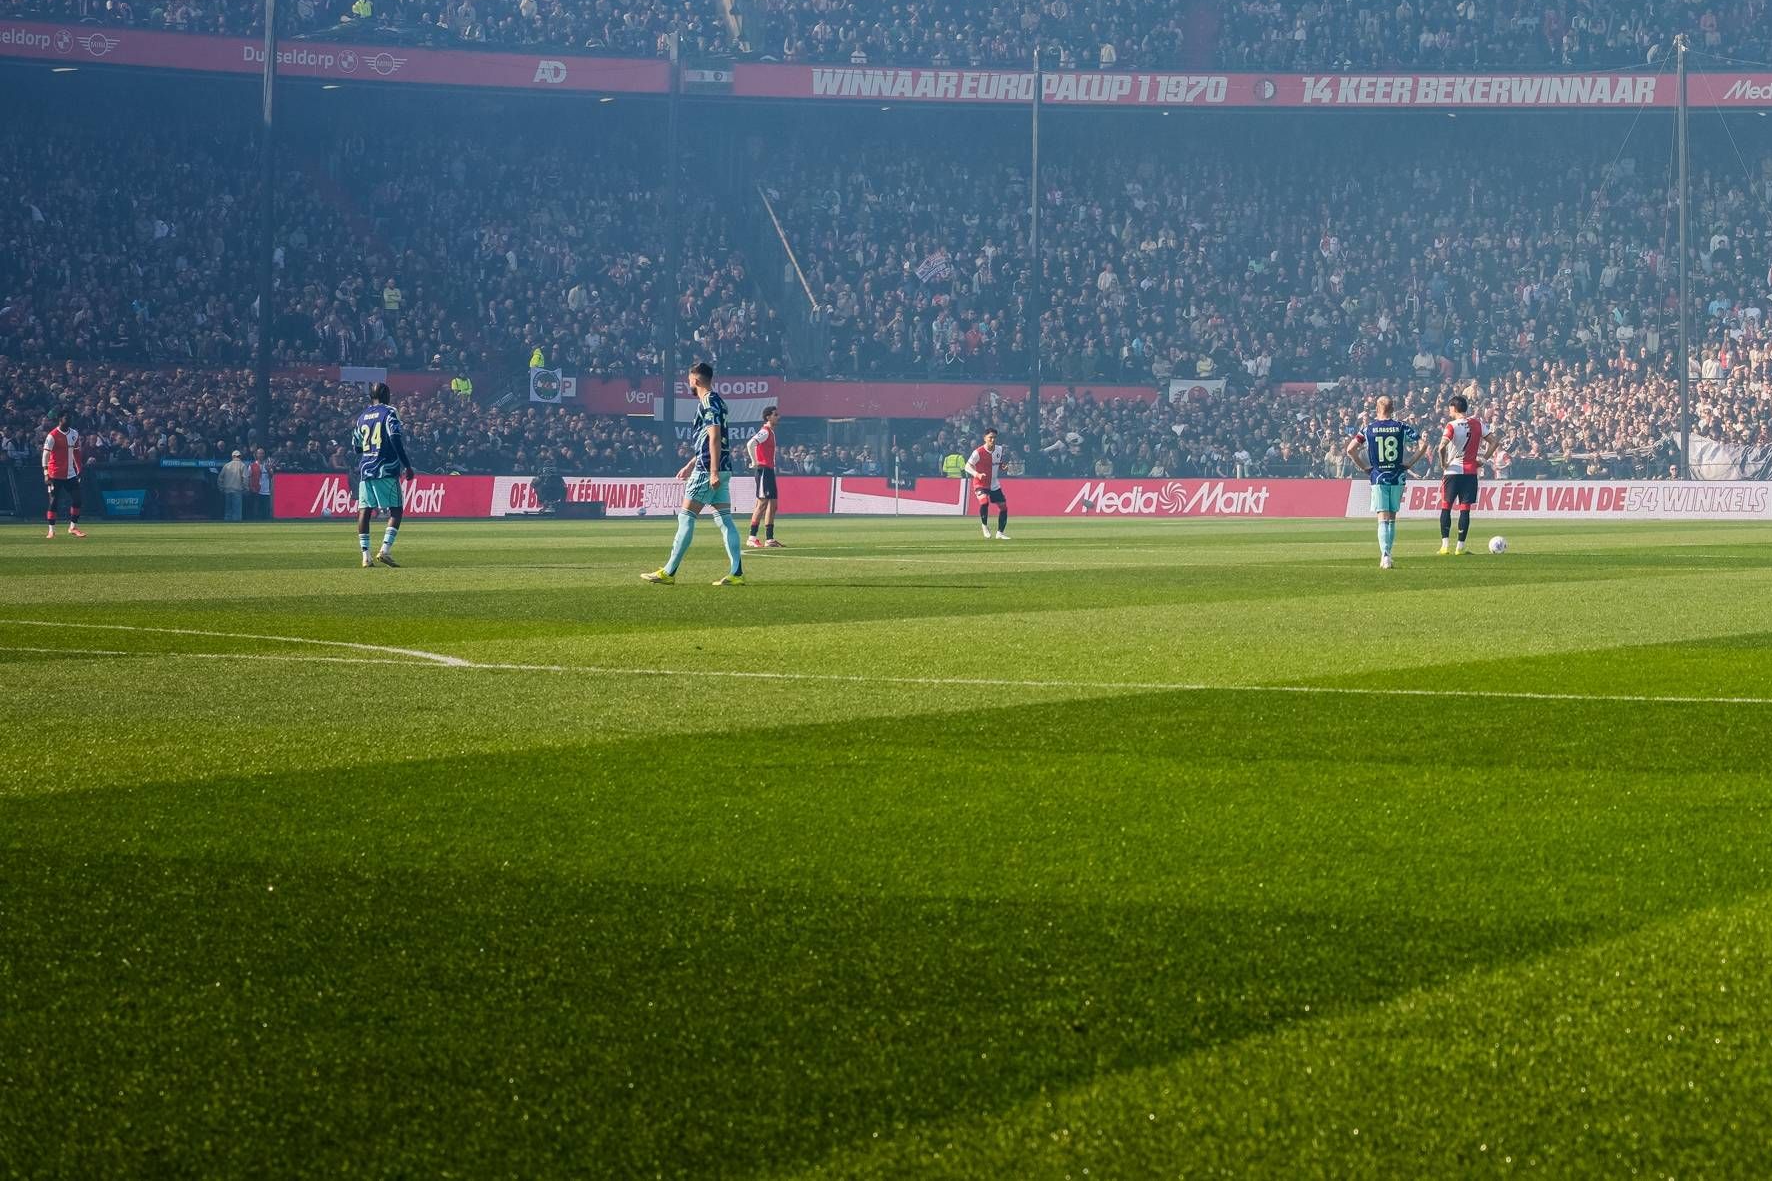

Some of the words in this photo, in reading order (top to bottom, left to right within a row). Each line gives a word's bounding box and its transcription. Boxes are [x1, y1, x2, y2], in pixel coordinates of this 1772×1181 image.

[0, 28, 51, 50] eldorp
[243, 46, 334, 68] Duseldorp
[534, 61, 567, 84] AD
[812, 69, 957, 98] WINNAAR
[1156, 76, 1228, 103] 1970
[1302, 77, 1333, 103] 14
[1337, 77, 1412, 103] KEER
[1415, 77, 1656, 104] BEKERWINNAAR
[361, 422, 382, 452] 24
[1375, 435, 1398, 463] 18
[509, 483, 528, 509] OF
[628, 483, 645, 509] DE
[1064, 481, 1158, 514] Media
[1183, 481, 1269, 514] Markt
[1497, 481, 1536, 512] ÉÉN
[1546, 486, 1596, 512] VAN
[1597, 486, 1628, 512] DE
[1627, 485, 1660, 512] 54
[1661, 486, 1769, 513] WINKELS
